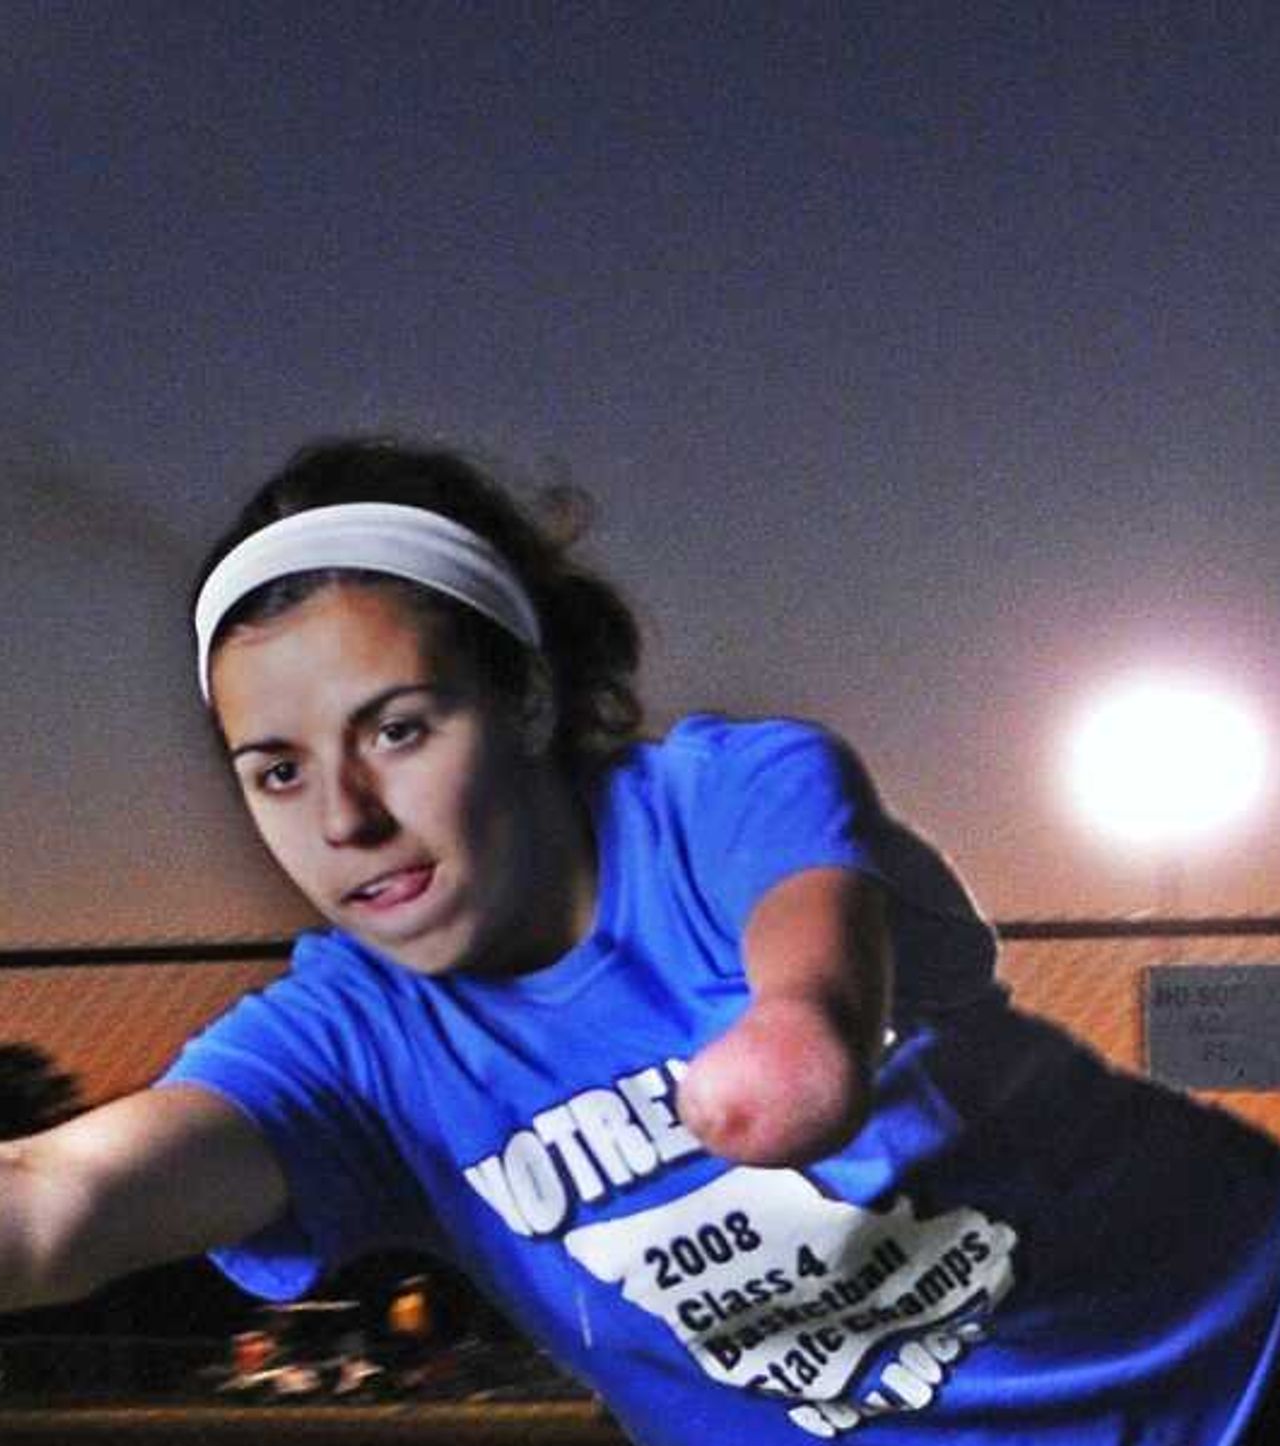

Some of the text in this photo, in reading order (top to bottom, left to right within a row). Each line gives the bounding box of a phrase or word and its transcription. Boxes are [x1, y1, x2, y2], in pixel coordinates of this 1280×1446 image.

[645, 1210, 761, 1290] 2008
[676, 1244, 828, 1332] Class 4
